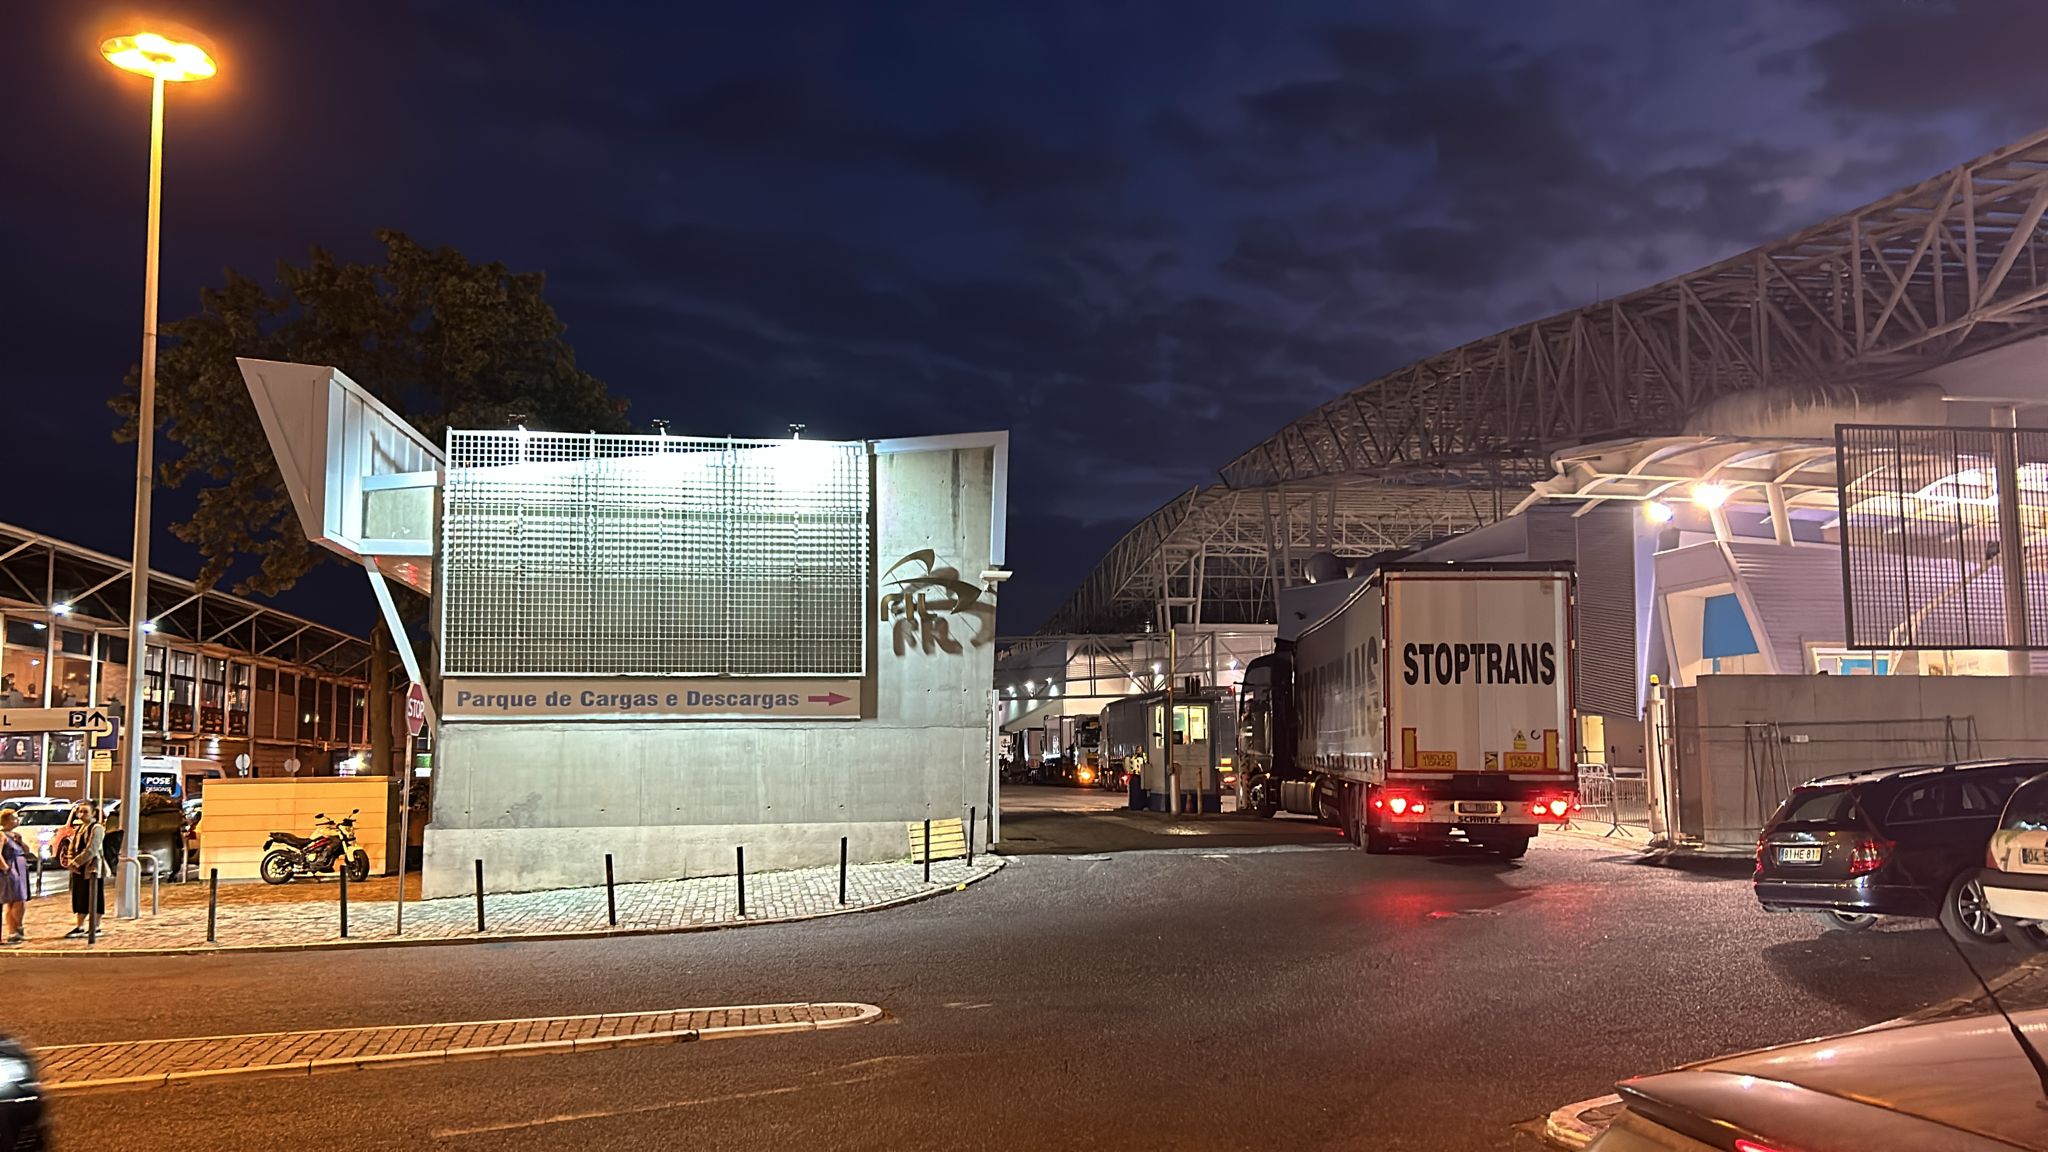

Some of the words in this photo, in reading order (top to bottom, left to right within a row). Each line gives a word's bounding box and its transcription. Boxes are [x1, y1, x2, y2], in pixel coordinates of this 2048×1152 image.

[1404, 642, 1556, 685] STOPTRANS
[408, 698, 424, 719] STOP
[457, 691, 537, 710] Parque
[545, 691, 572, 707] de
[580, 690, 658, 709] Cargas
[666, 694, 678, 706] e
[687, 691, 799, 709] Descargas
[1458, 816, 1501, 824] SCHMITZ
